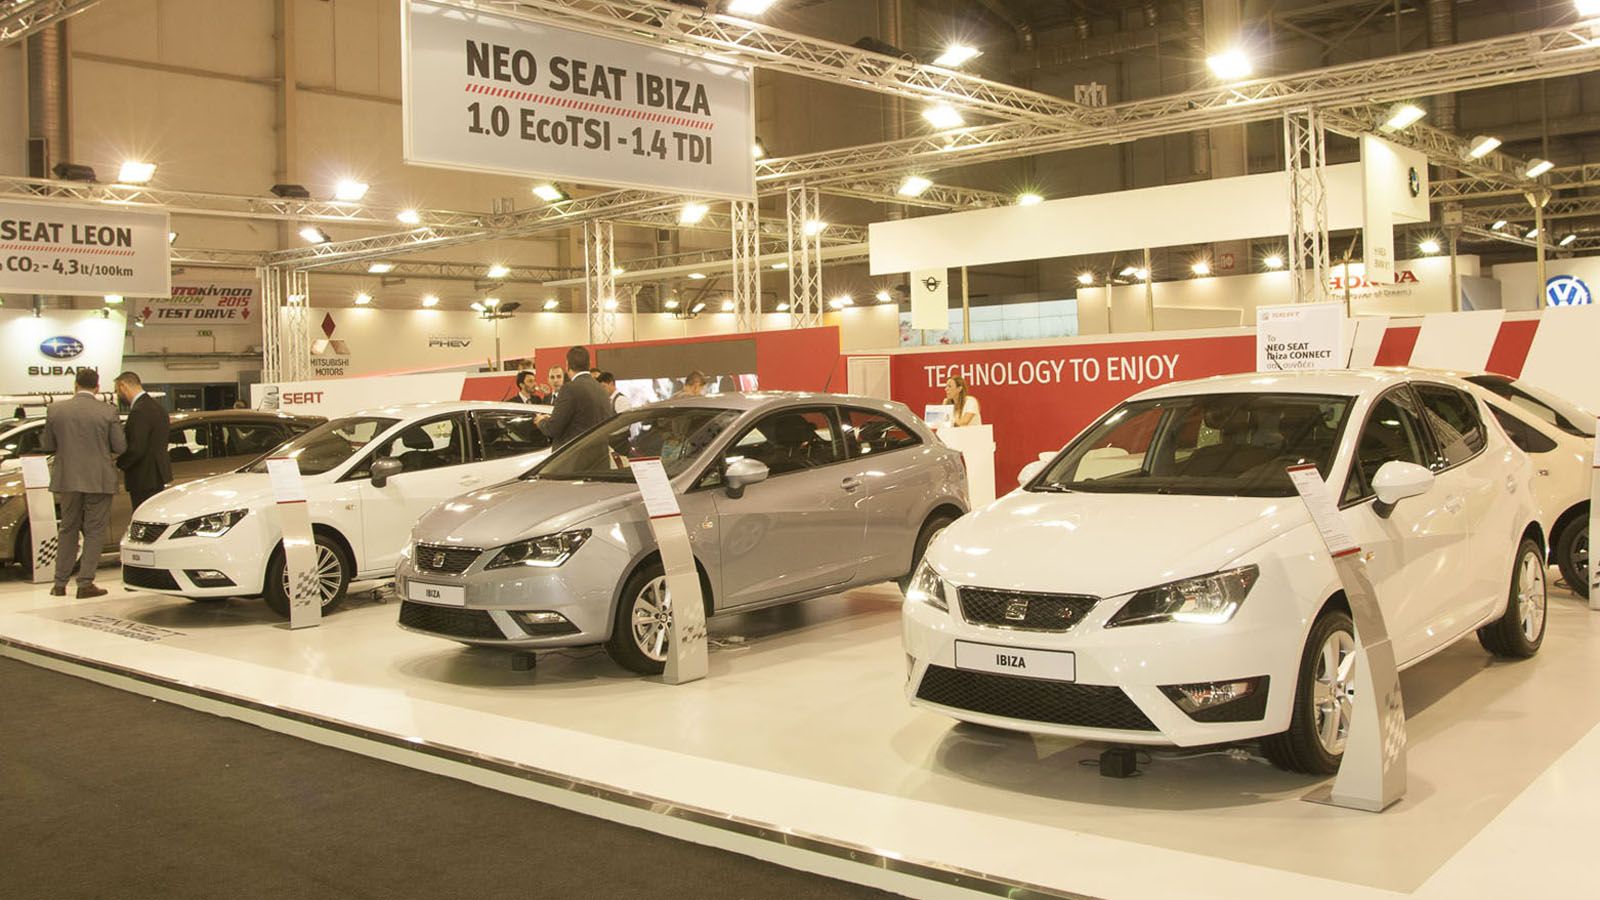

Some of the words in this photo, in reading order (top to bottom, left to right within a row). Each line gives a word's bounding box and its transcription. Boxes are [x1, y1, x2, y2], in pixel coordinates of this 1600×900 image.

[466, 40, 537, 86] NEO
[549, 56, 627, 101] SEAT
[637, 72, 711, 116] IBIZA
[467, 102, 510, 137] 1.0
[520, 108, 610, 151] EcoTSI
[673, 132, 712, 164] TDI
[0, 219, 63, 243] SEAT
[71, 224, 132, 248] LEON
[1329, 270, 1419, 289] HONA
[218, 297, 251, 307] 2015
[158, 308, 192, 319] TEST
[194, 308, 237, 319] DRIVE
[429, 340, 471, 348] PHEV
[1267, 343, 1285, 351] NEO
[1287, 342, 1309, 351] SEAT
[1266, 352, 1287, 360] Ibiza
[1289, 350, 1331, 359] CONNECT
[311, 358, 349, 367] MITSUBISHI
[315, 368, 344, 376] MOTORS
[923, 359, 1065, 388] TECHNOLOGY
[1069, 358, 1100, 382] TO
[1107, 353, 1180, 385] ENJOY
[283, 391, 324, 405] SEAT
[996, 654, 1026, 668] IBIZA
